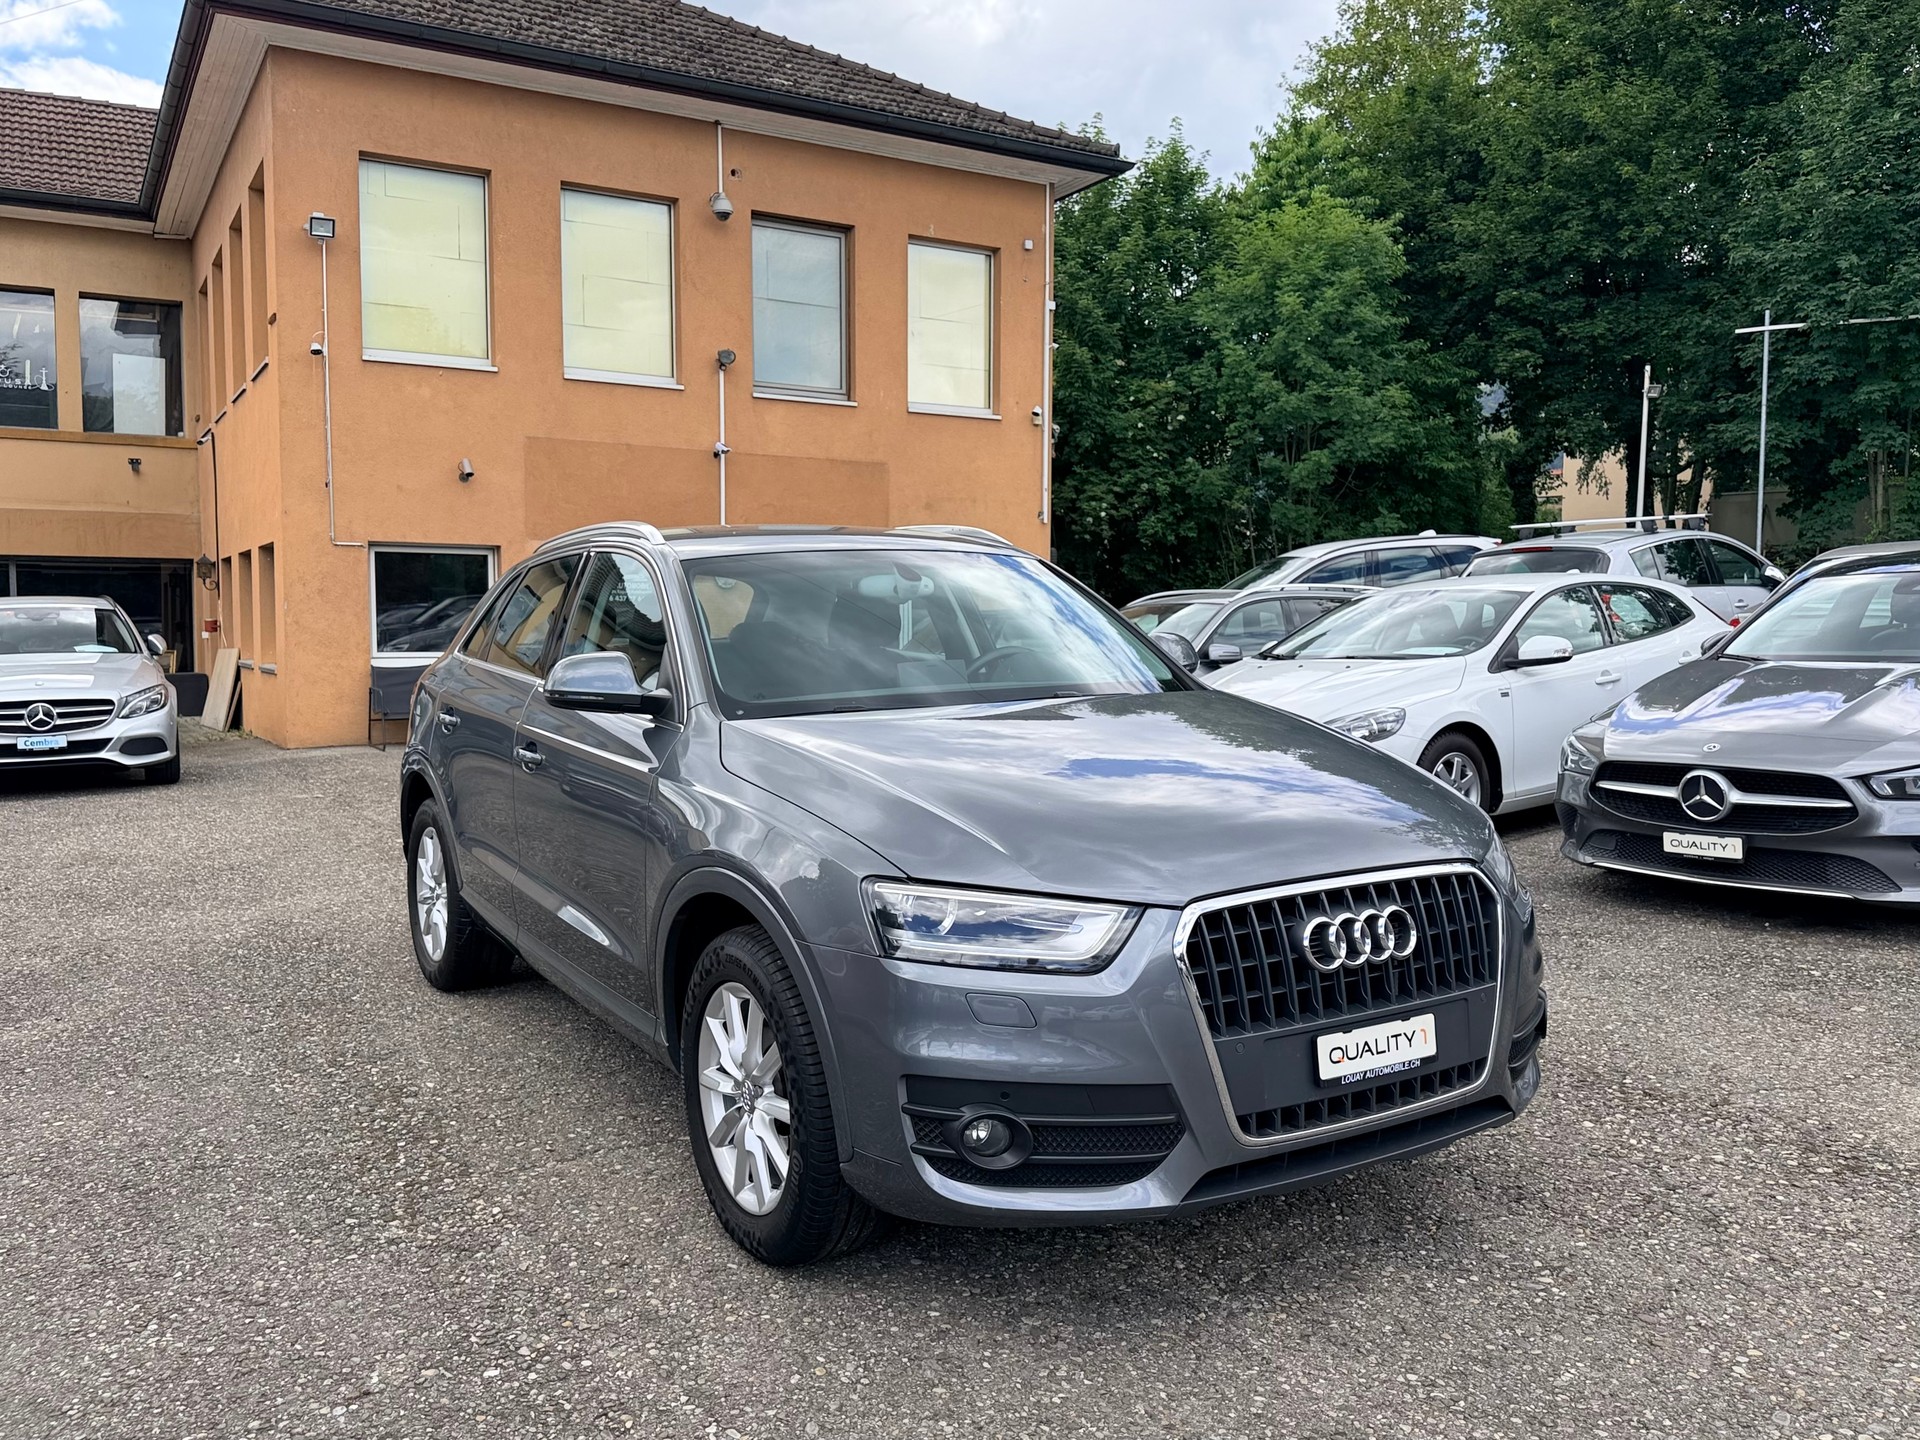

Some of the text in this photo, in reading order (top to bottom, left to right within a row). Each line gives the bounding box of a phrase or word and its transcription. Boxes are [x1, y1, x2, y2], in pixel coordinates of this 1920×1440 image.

[23, 738, 60, 747] Cembra
[1669, 838, 1728, 852] QUALITY
[1329, 1028, 1428, 1064] QUALITY 1
[1341, 1058, 1421, 1085] LOUAY AUTOMOBILE.CH
